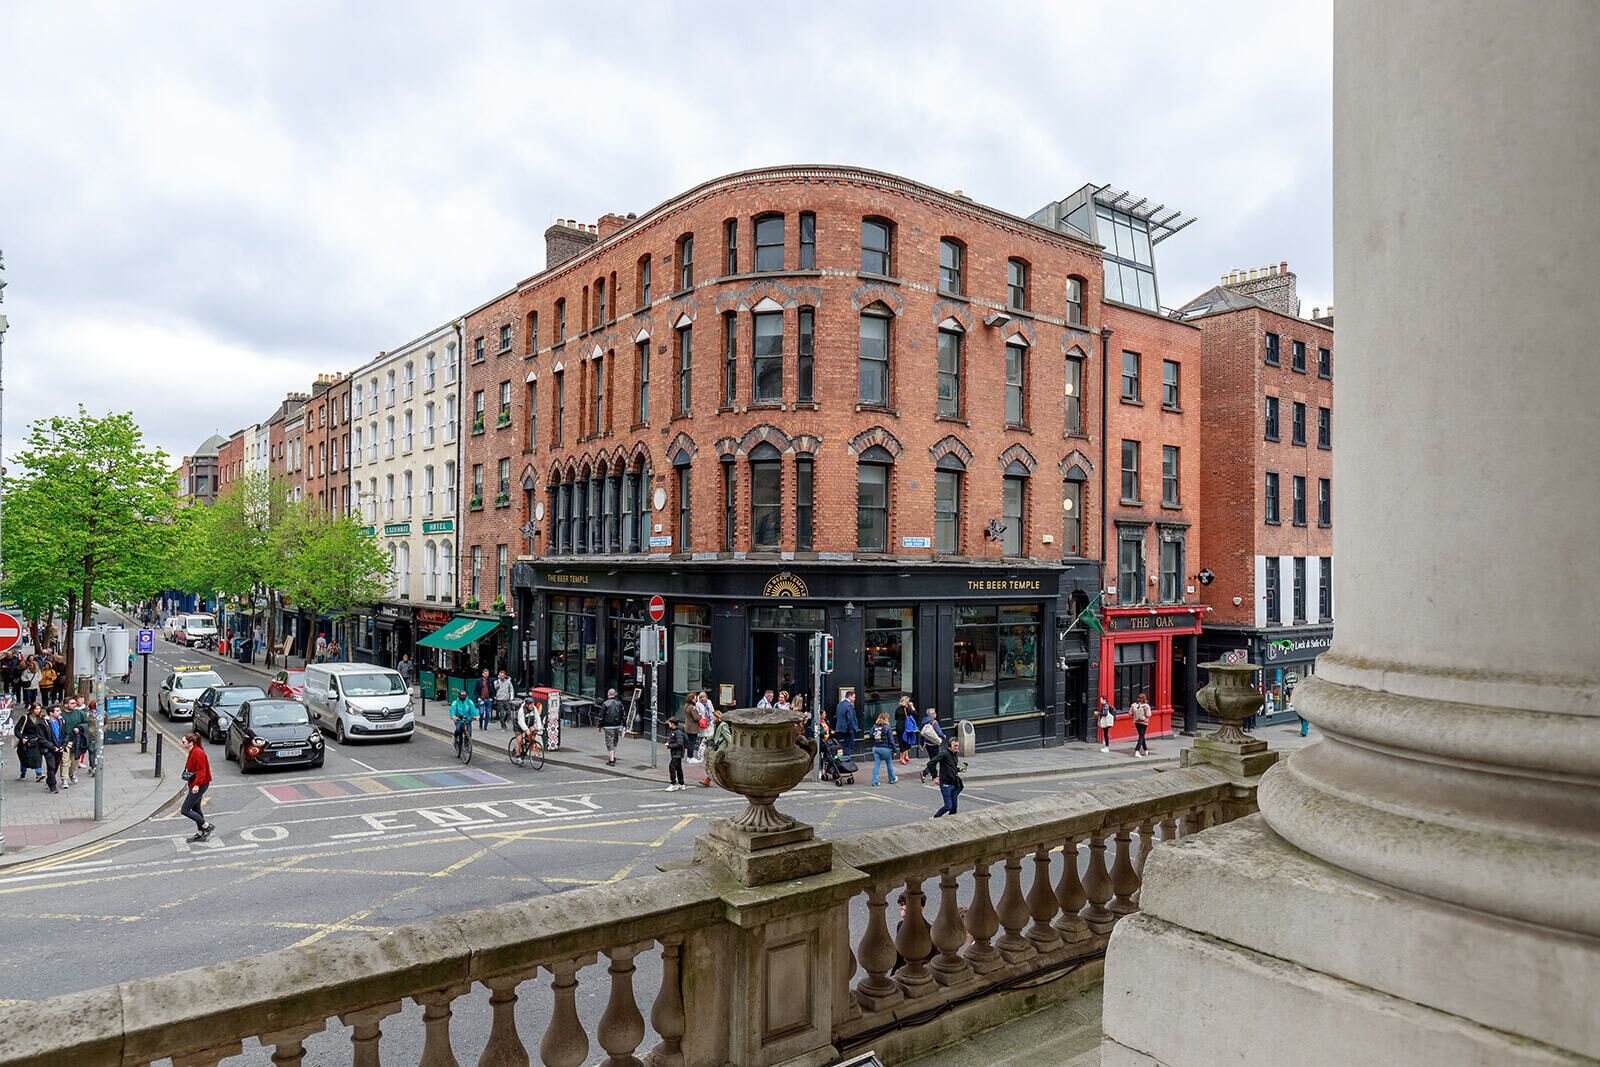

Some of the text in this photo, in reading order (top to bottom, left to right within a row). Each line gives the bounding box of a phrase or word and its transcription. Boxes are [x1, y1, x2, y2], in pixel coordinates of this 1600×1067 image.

[429, 522, 446, 531] HOTEL
[547, 574, 589, 584] THE BEER TEMPLE
[968, 580, 1040, 590] THE BEER TEMPLE
[1130, 617, 1150, 629] THE
[1155, 616, 1174, 627] OAK
[171, 794, 602, 852] NO ENTRY
